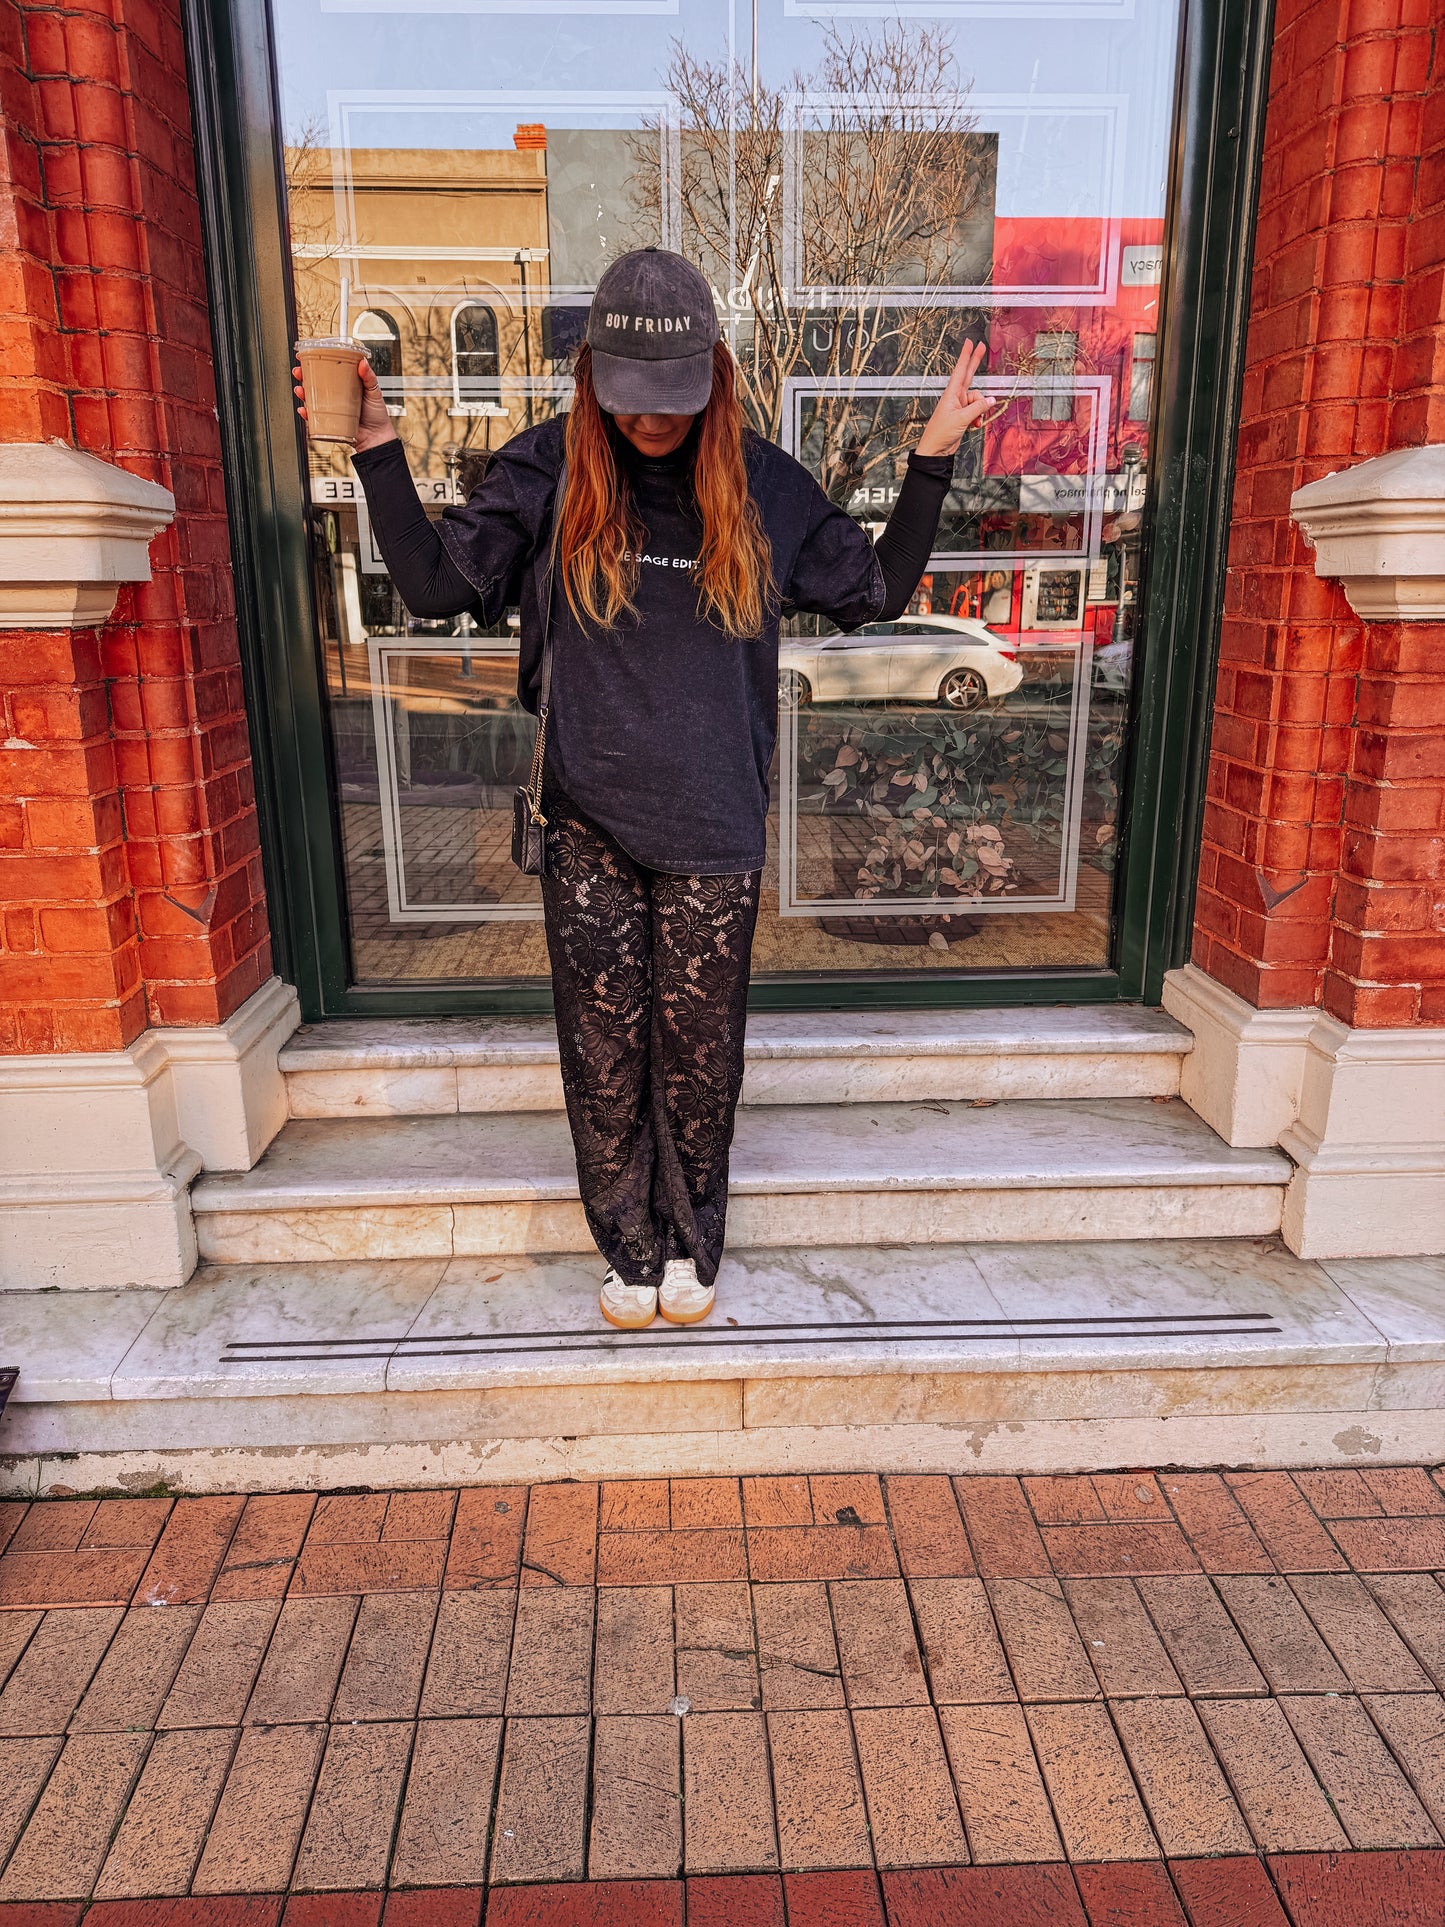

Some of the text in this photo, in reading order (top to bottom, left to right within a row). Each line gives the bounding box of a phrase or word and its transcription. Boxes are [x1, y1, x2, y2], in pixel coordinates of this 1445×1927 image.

[606, 313, 691, 333] BOY FRIDAY
[635, 554, 669, 567] SAGE
